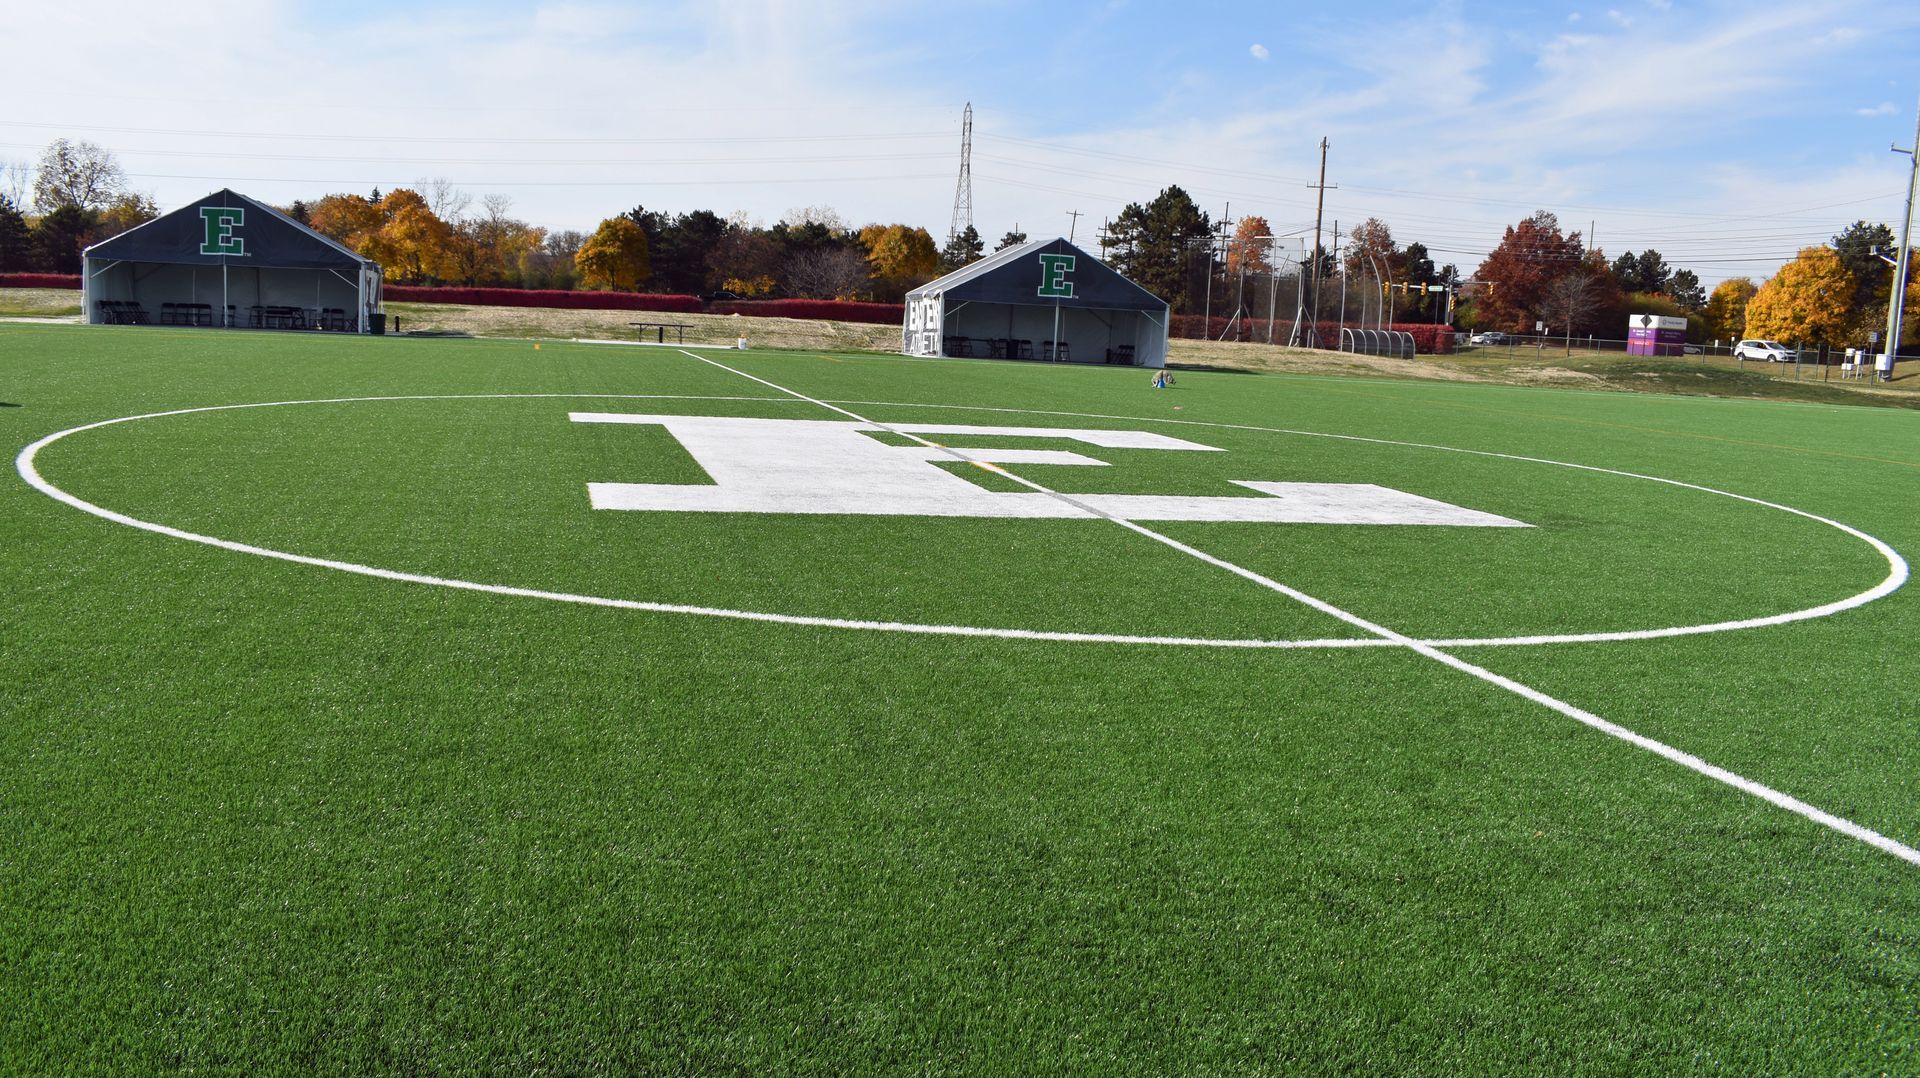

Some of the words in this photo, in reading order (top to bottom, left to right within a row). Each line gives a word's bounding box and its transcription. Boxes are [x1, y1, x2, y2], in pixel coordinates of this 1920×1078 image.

[199, 206, 245, 257] E
[1037, 253, 1076, 299] E
[568, 411, 1537, 529] E
